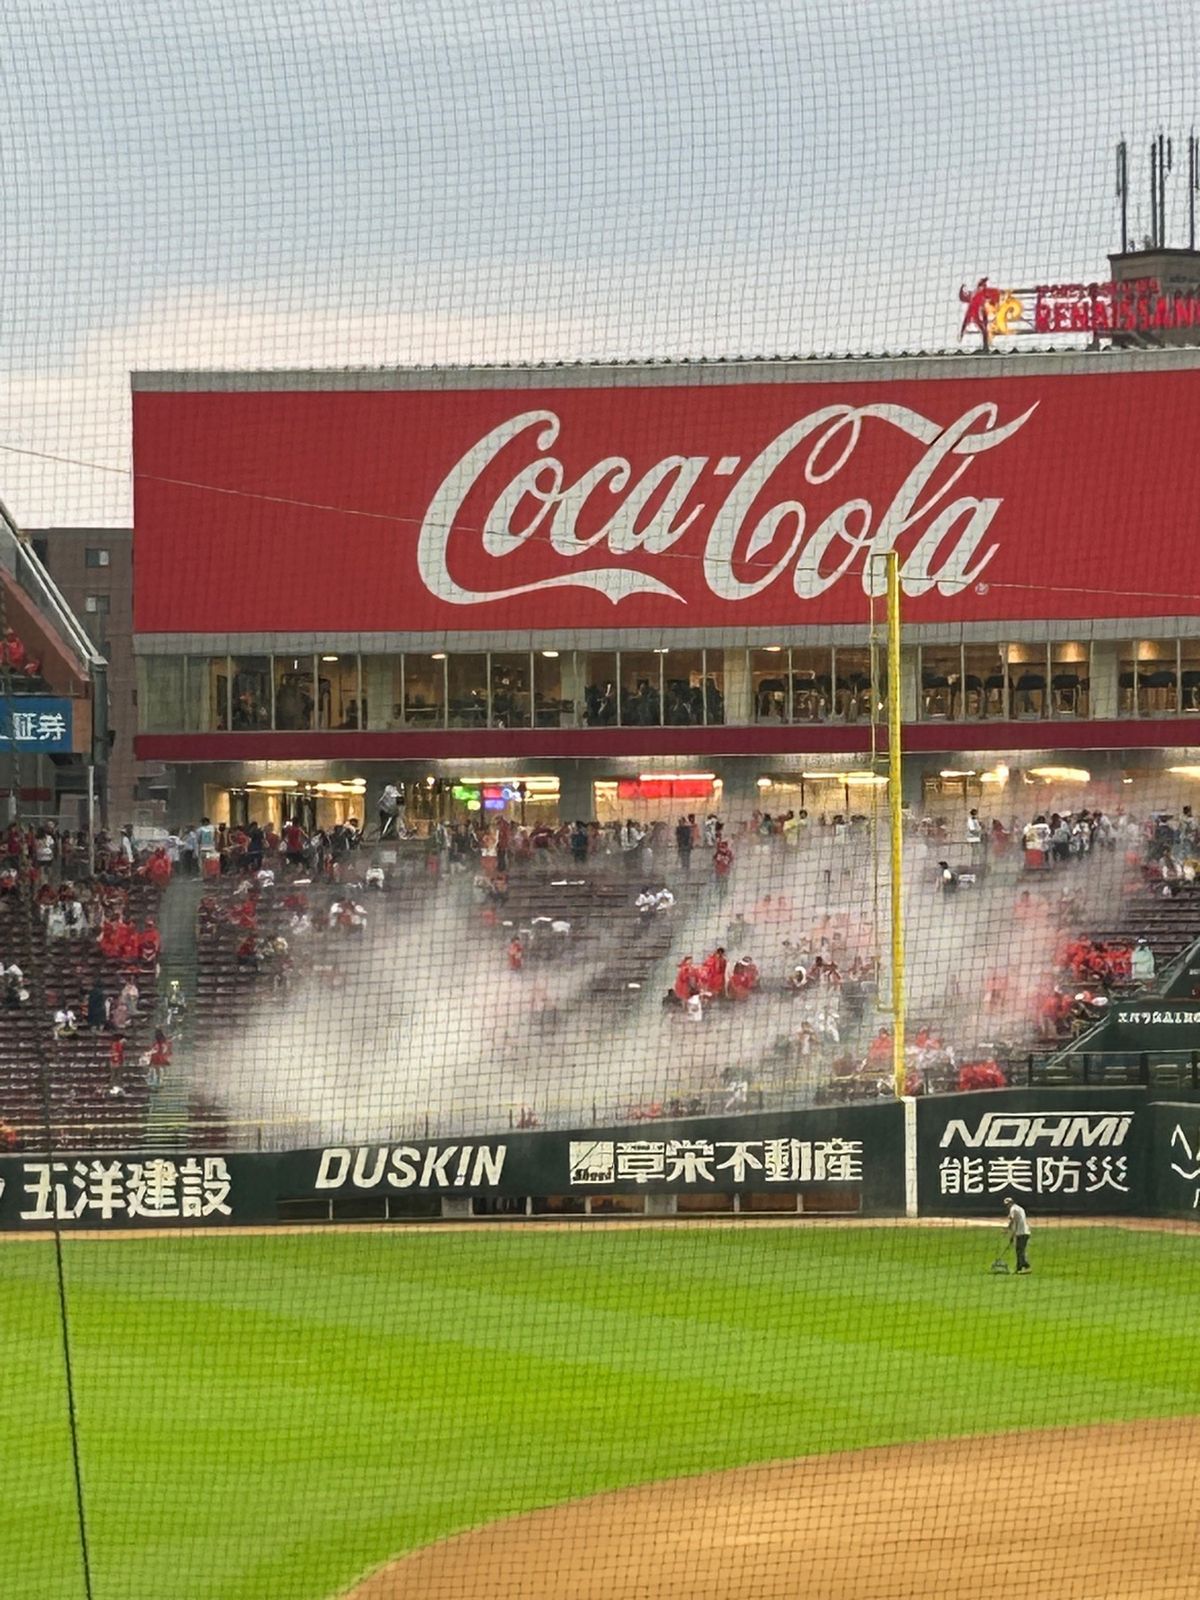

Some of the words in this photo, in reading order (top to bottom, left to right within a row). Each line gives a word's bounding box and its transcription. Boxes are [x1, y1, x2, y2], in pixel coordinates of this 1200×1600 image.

[417, 400, 1041, 604] Coca-Cola
[0, 712, 67, 741] 証券
[939, 1111, 1135, 1148] NOHMI
[616, 1138, 864, 1184] 章栄不動産
[939, 1156, 1131, 1194] 能美防災
[20, 1157, 233, 1220] 五洋建設
